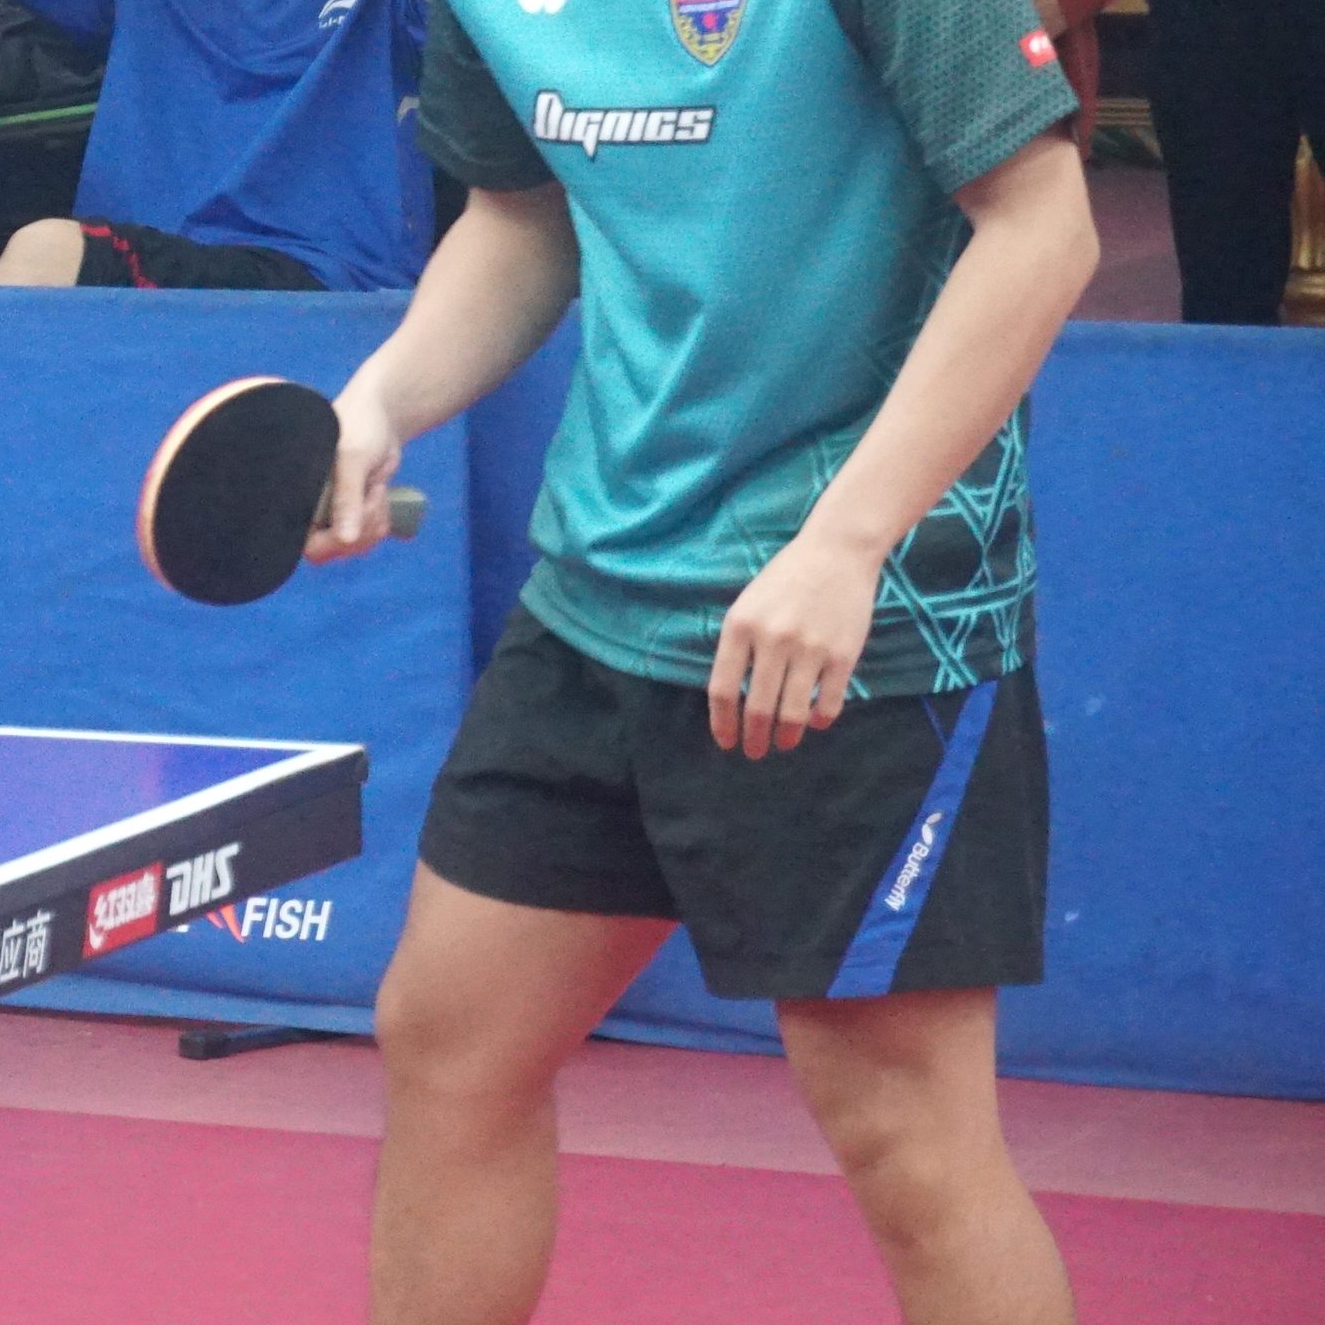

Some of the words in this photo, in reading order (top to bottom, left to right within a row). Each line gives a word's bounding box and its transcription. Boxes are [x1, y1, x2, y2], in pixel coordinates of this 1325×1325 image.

[166, 841, 241, 916] DHS
[884, 842, 929, 911] Butterfly
[242, 897, 331, 941] FISH
